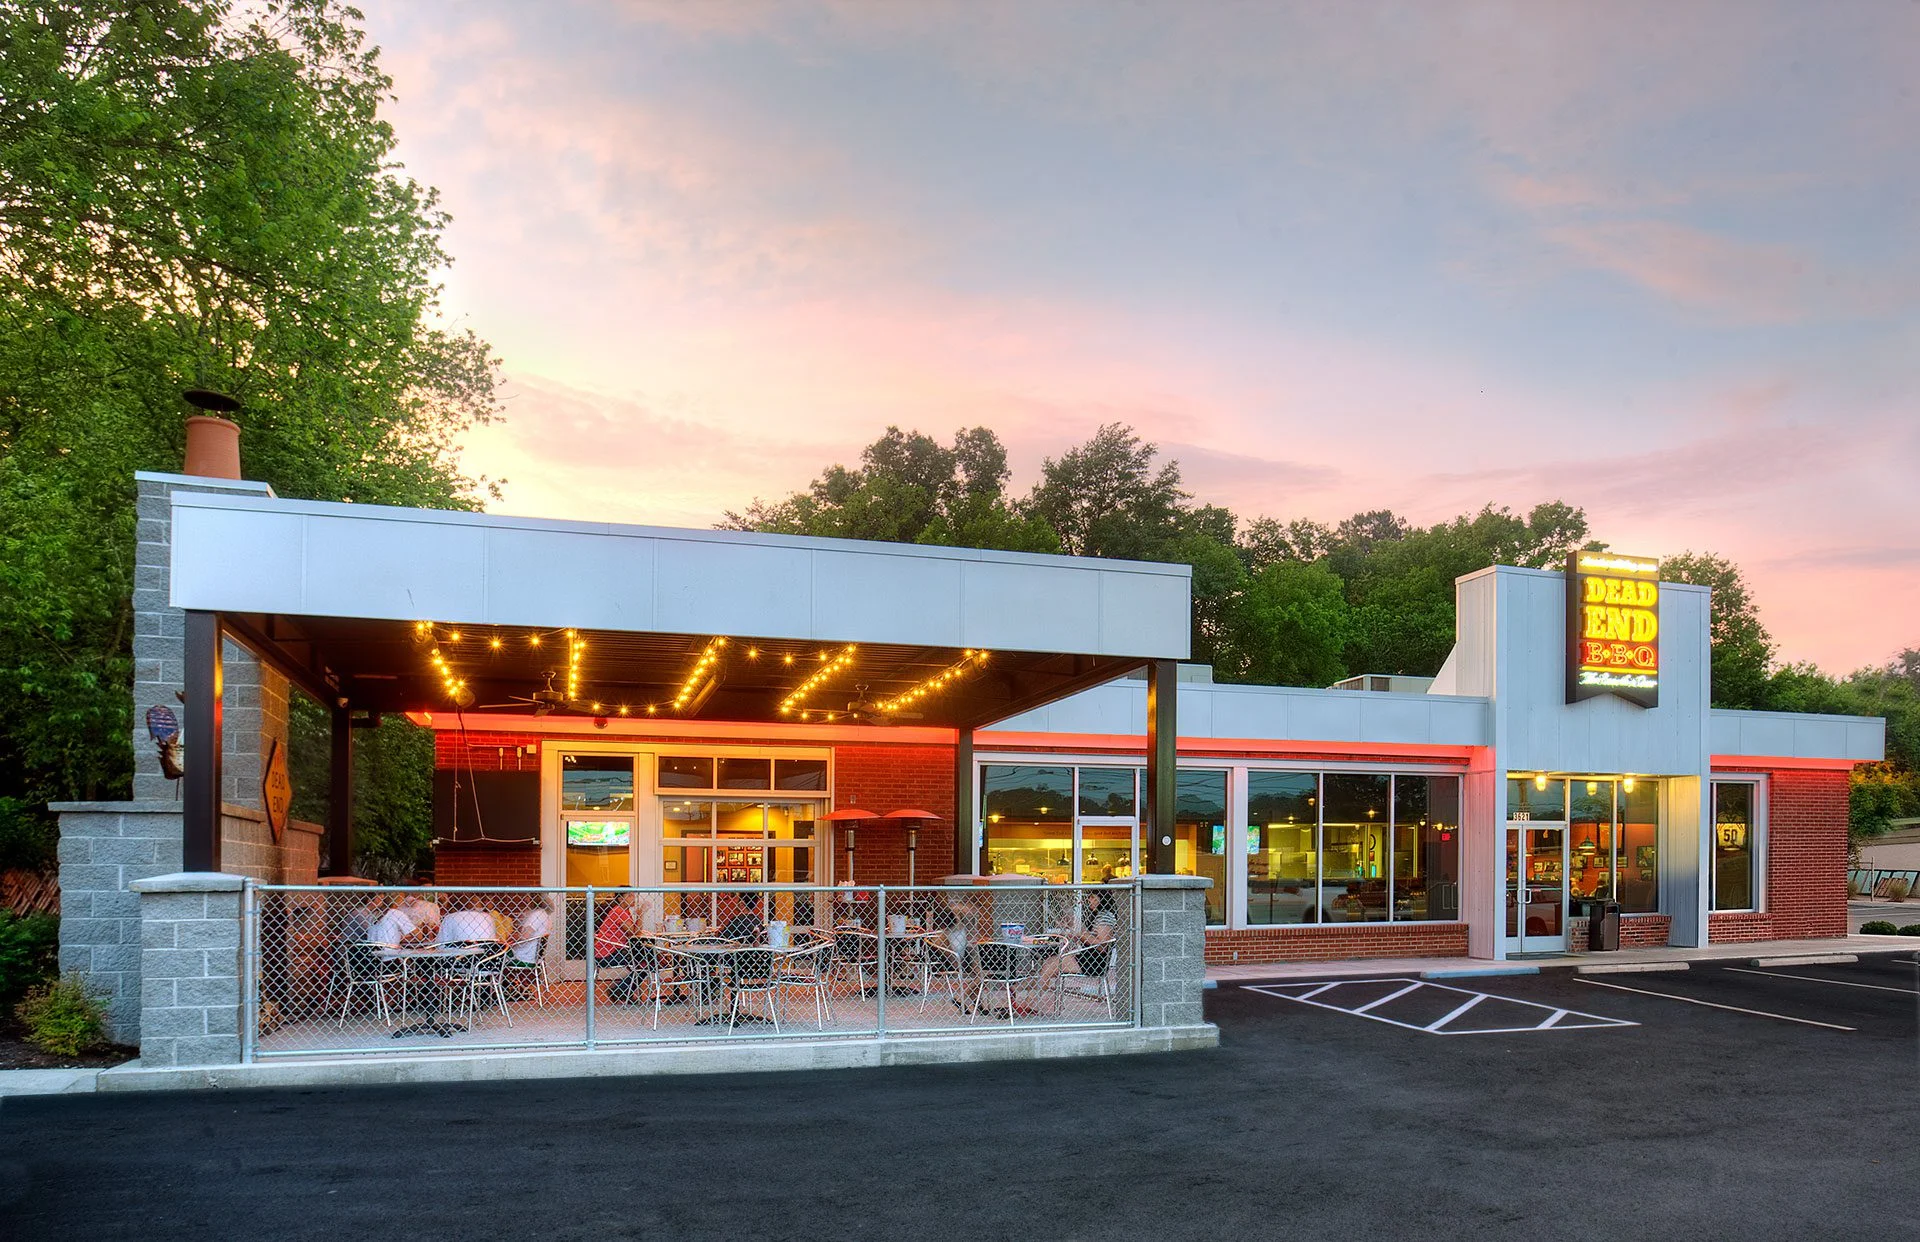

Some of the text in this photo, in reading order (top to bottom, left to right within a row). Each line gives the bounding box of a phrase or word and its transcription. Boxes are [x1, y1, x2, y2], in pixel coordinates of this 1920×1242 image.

[1585, 576, 1658, 607] DEAD
[1585, 605, 1658, 642] END
[273, 796, 283, 813] END
[1723, 829, 1738, 842] 50
